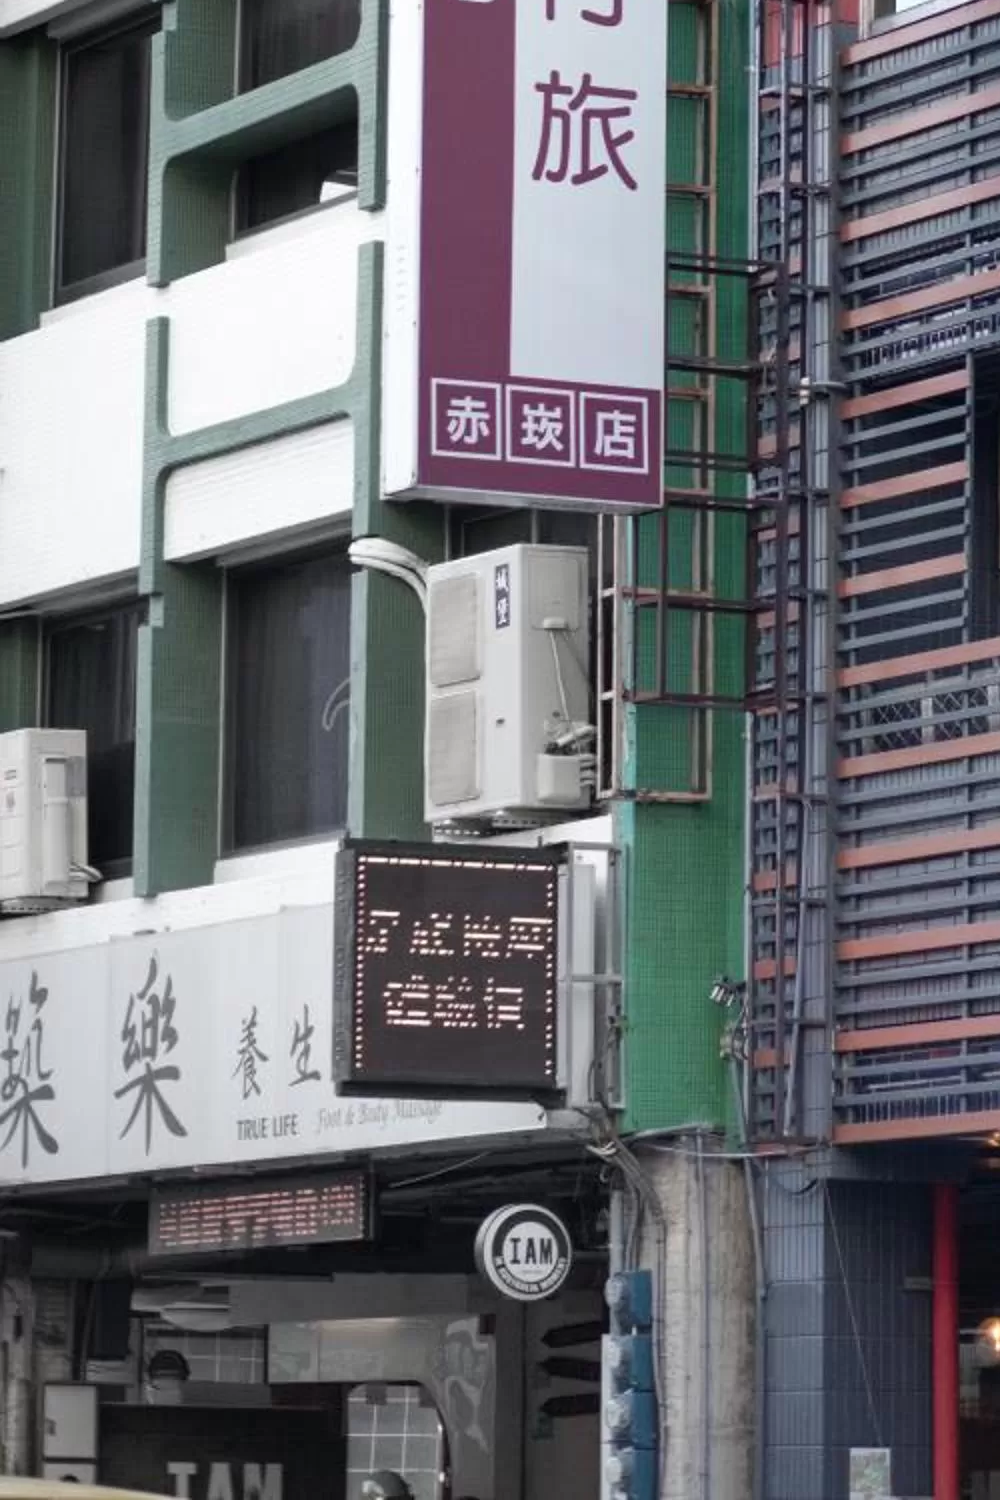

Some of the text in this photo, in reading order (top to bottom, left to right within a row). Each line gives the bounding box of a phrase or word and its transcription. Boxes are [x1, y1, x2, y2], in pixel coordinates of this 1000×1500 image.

[447, 395, 638, 459] 赤崁店
[236, 1118, 268, 1140] TRUE
[273, 1113, 299, 1137] LIFE
